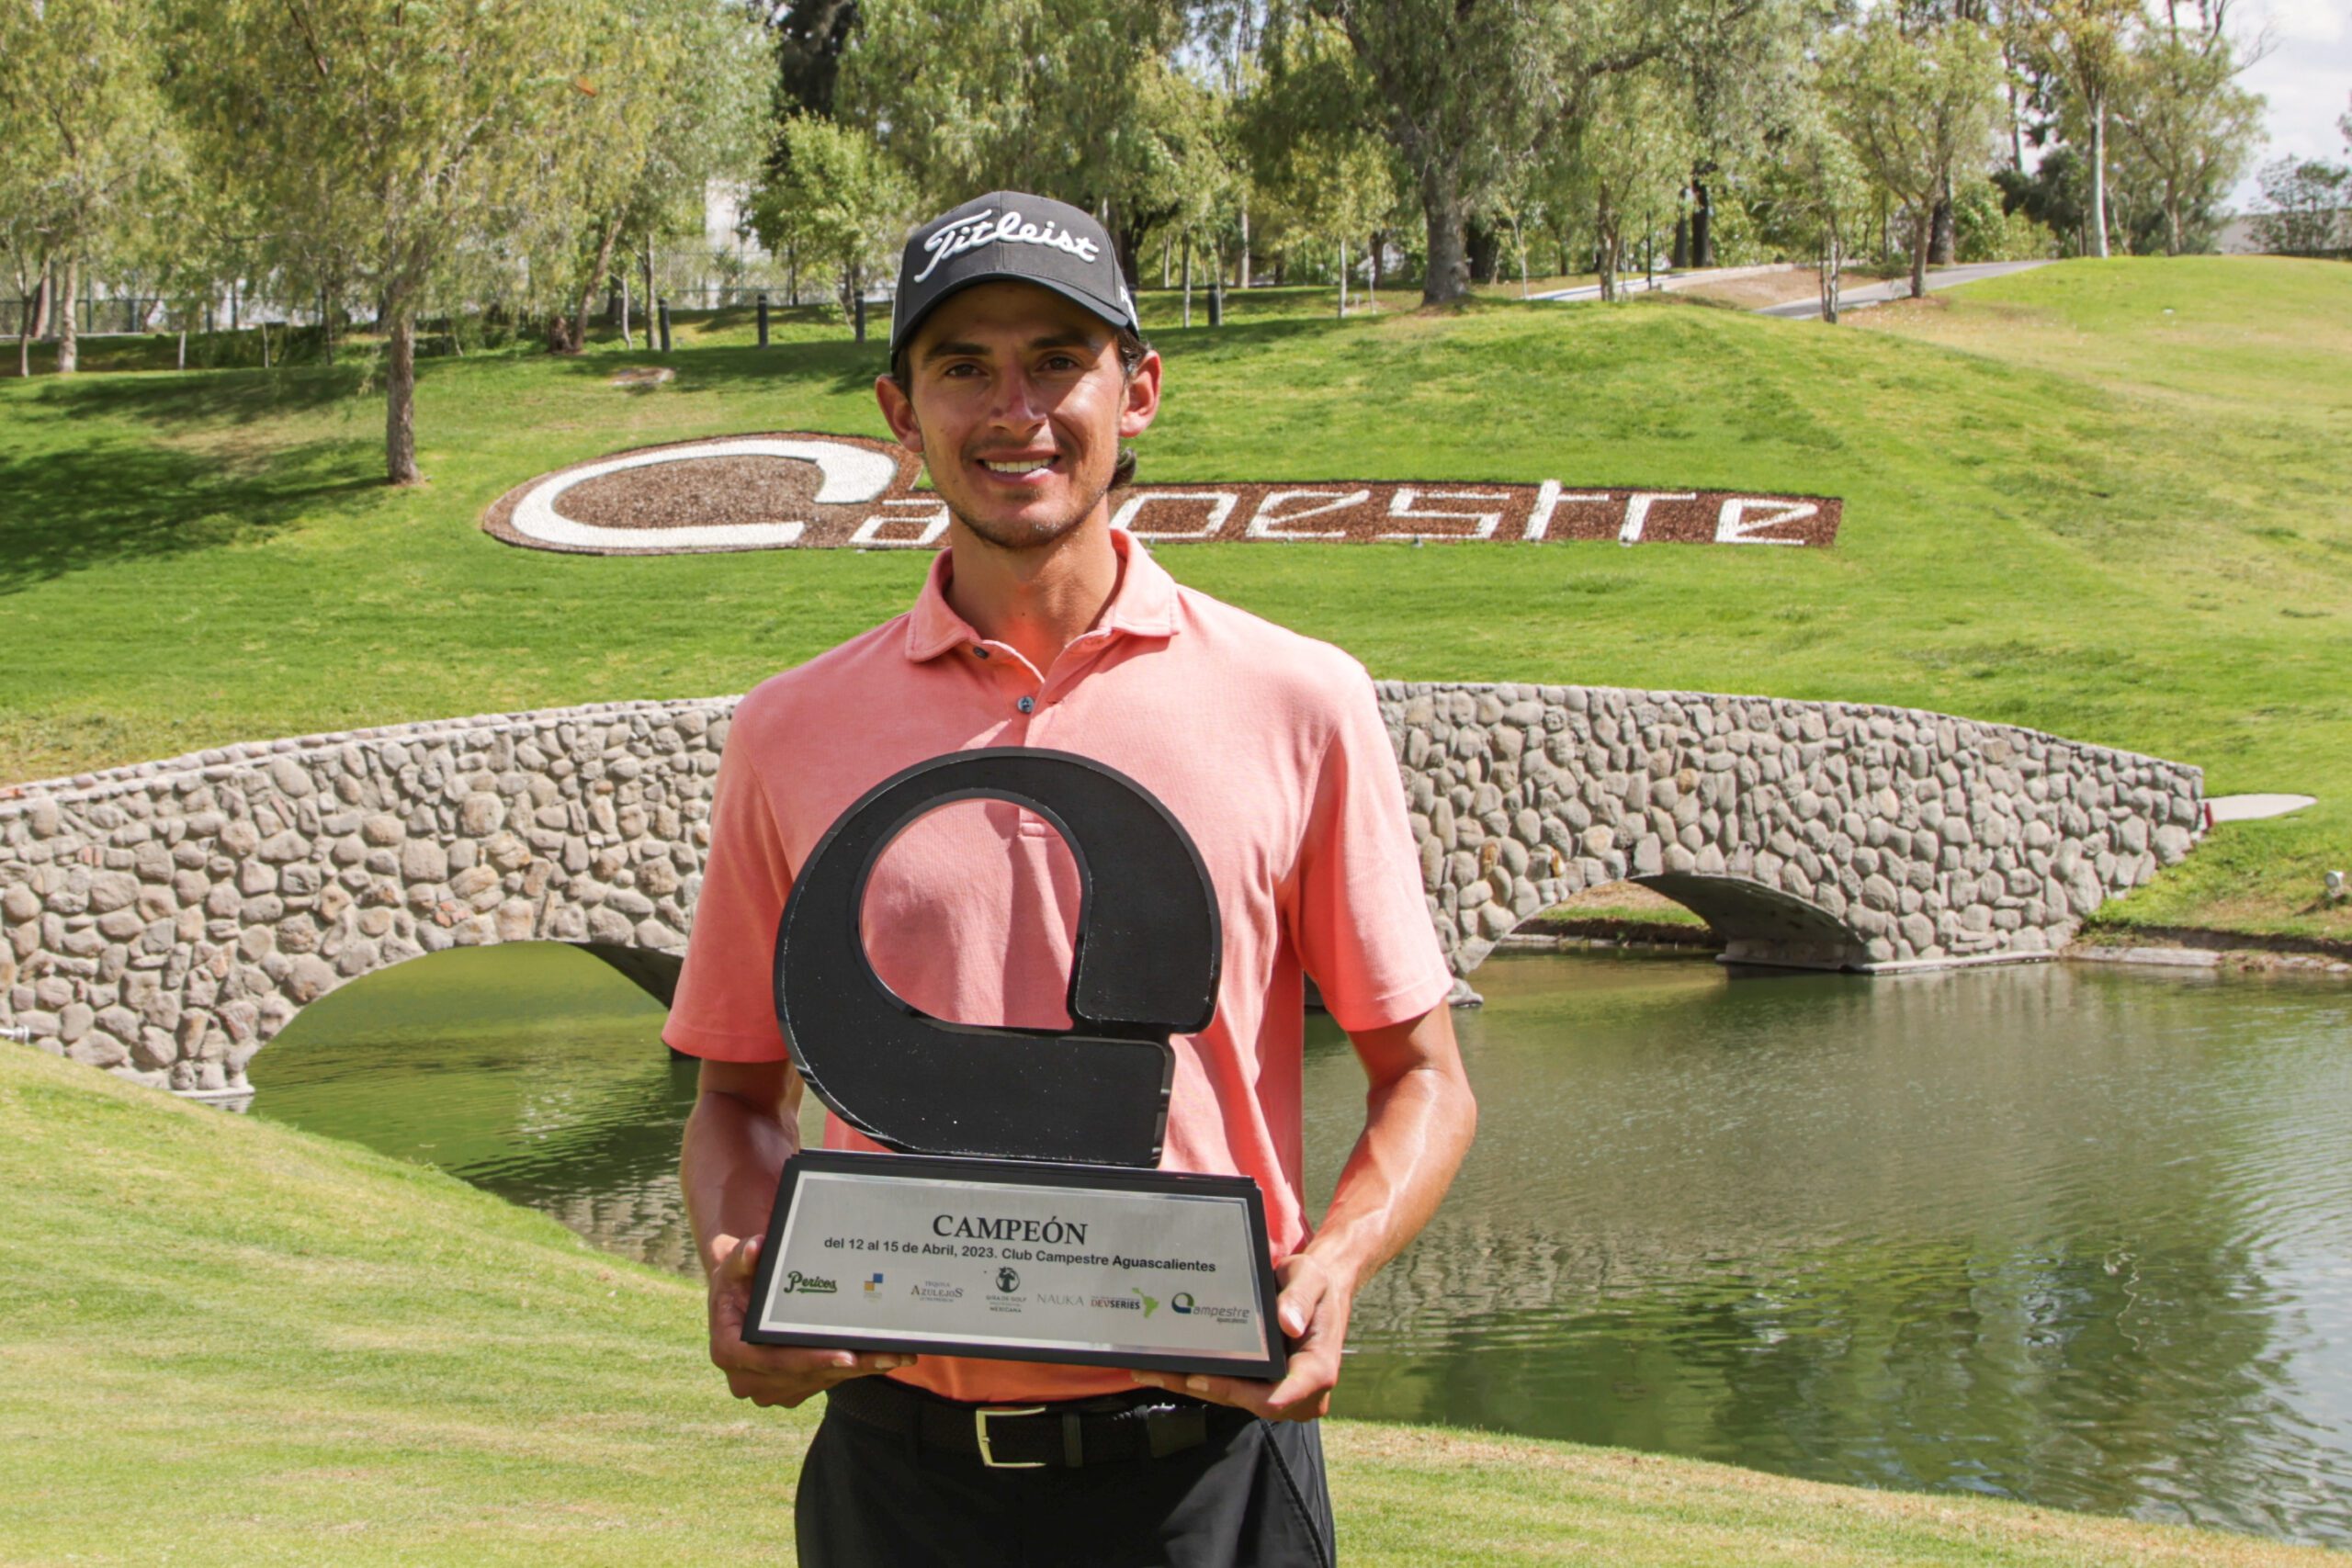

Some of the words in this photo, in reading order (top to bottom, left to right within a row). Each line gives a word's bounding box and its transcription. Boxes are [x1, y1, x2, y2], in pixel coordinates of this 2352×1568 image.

[914, 209, 1099, 283] Titleist
[933, 1214, 1088, 1246] CAMPEÓN
[824, 1237, 844, 1249] del
[849, 1238, 864, 1250] 12
[867, 1240, 879, 1251] al
[884, 1241, 899, 1252] 15
[902, 1242, 919, 1254] de
[922, 1243, 957, 1258] Abril,
[961, 1246, 998, 1258] 2023.
[1001, 1247, 1033, 1260] Club
[1035, 1250, 1109, 1266] Campestre
[1112, 1255, 1216, 1272] Aguascalientes
[784, 1270, 838, 1293] Pericos
[1036, 1293, 1084, 1306] NAUKA
